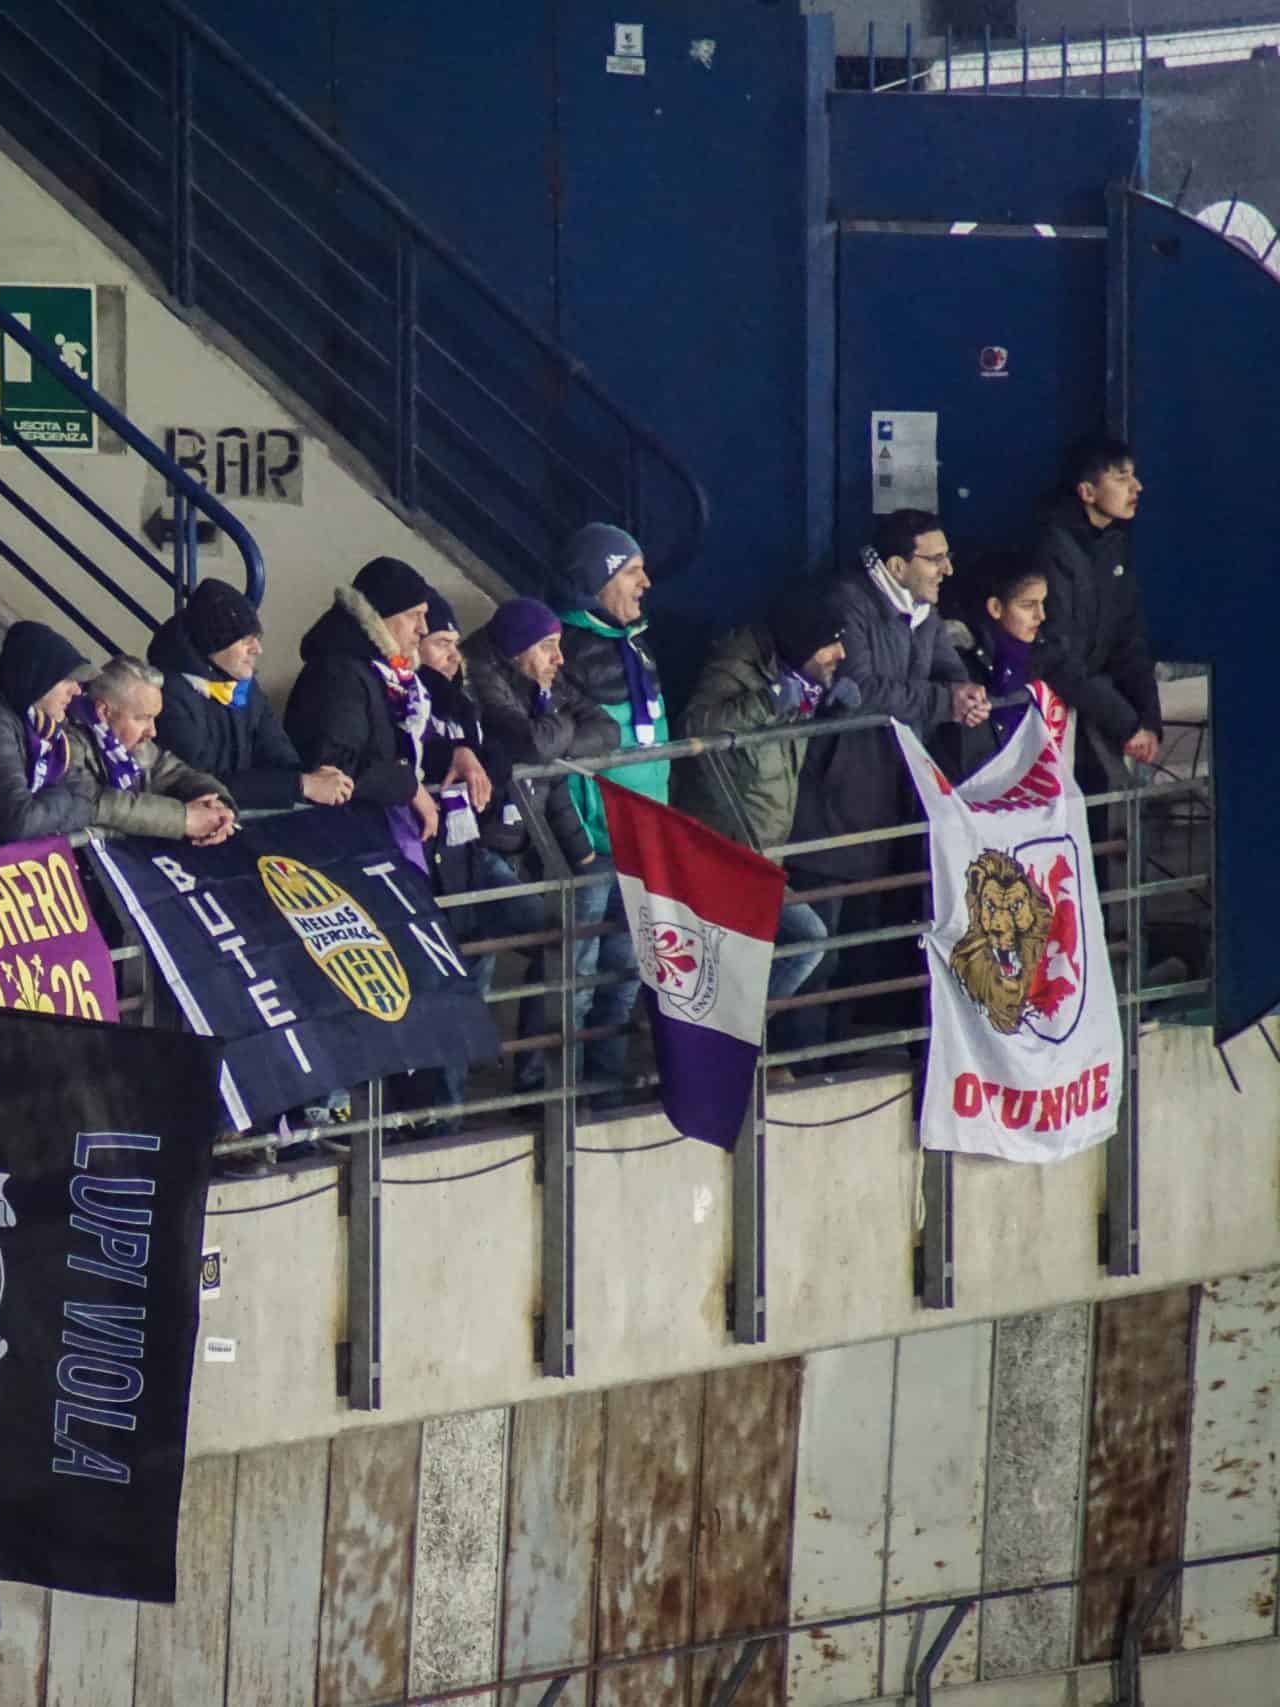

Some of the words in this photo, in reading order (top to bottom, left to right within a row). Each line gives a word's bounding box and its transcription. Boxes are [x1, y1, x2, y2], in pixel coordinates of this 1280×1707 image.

[3, 431, 89, 442] ERGENZA
[13, 420, 61, 431] USCITA
[66, 421, 80, 432] DI
[165, 426, 299, 497] BAR
[294, 905, 359, 932] HELLAS
[306, 925, 381, 952] VERONA
[152, 856, 312, 1073] BUTEI
[67, 1131, 160, 1288] LUPI
[52, 1301, 146, 1484] VIOLA
